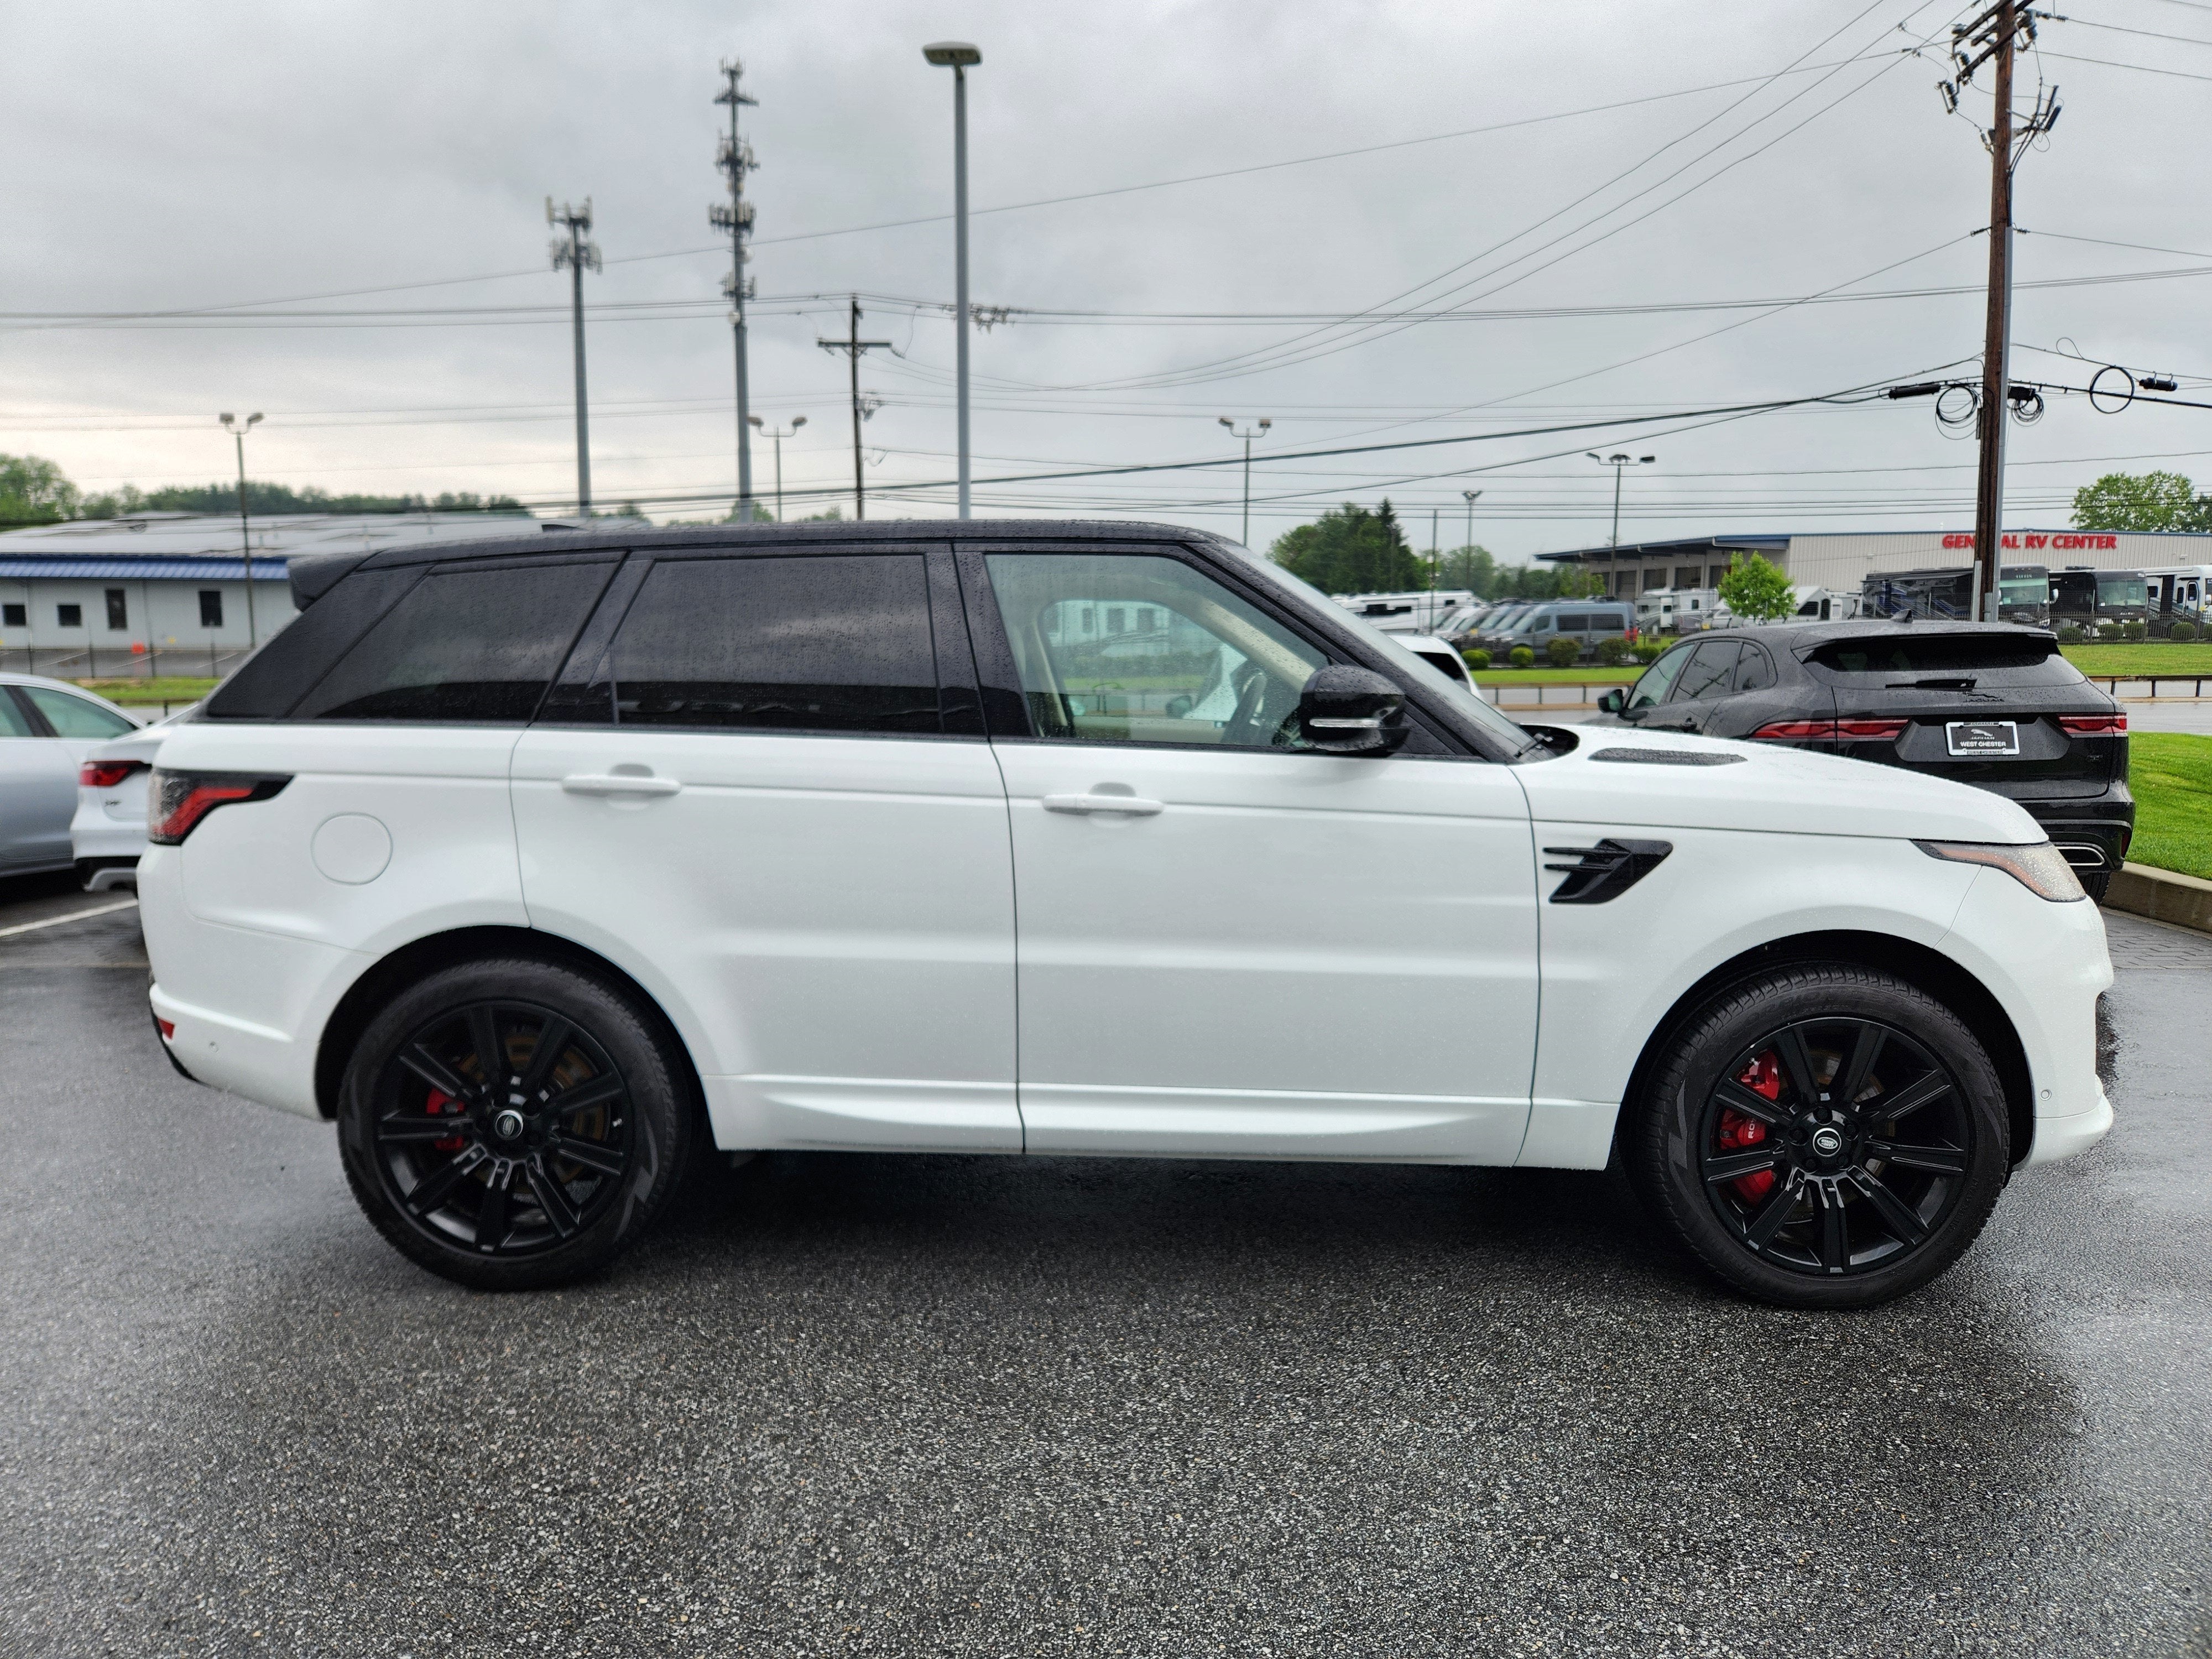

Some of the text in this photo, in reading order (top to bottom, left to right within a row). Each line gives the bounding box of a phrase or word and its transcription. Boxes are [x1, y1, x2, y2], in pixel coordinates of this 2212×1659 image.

[1942, 535, 2117, 549] GENAL RV CENTER
